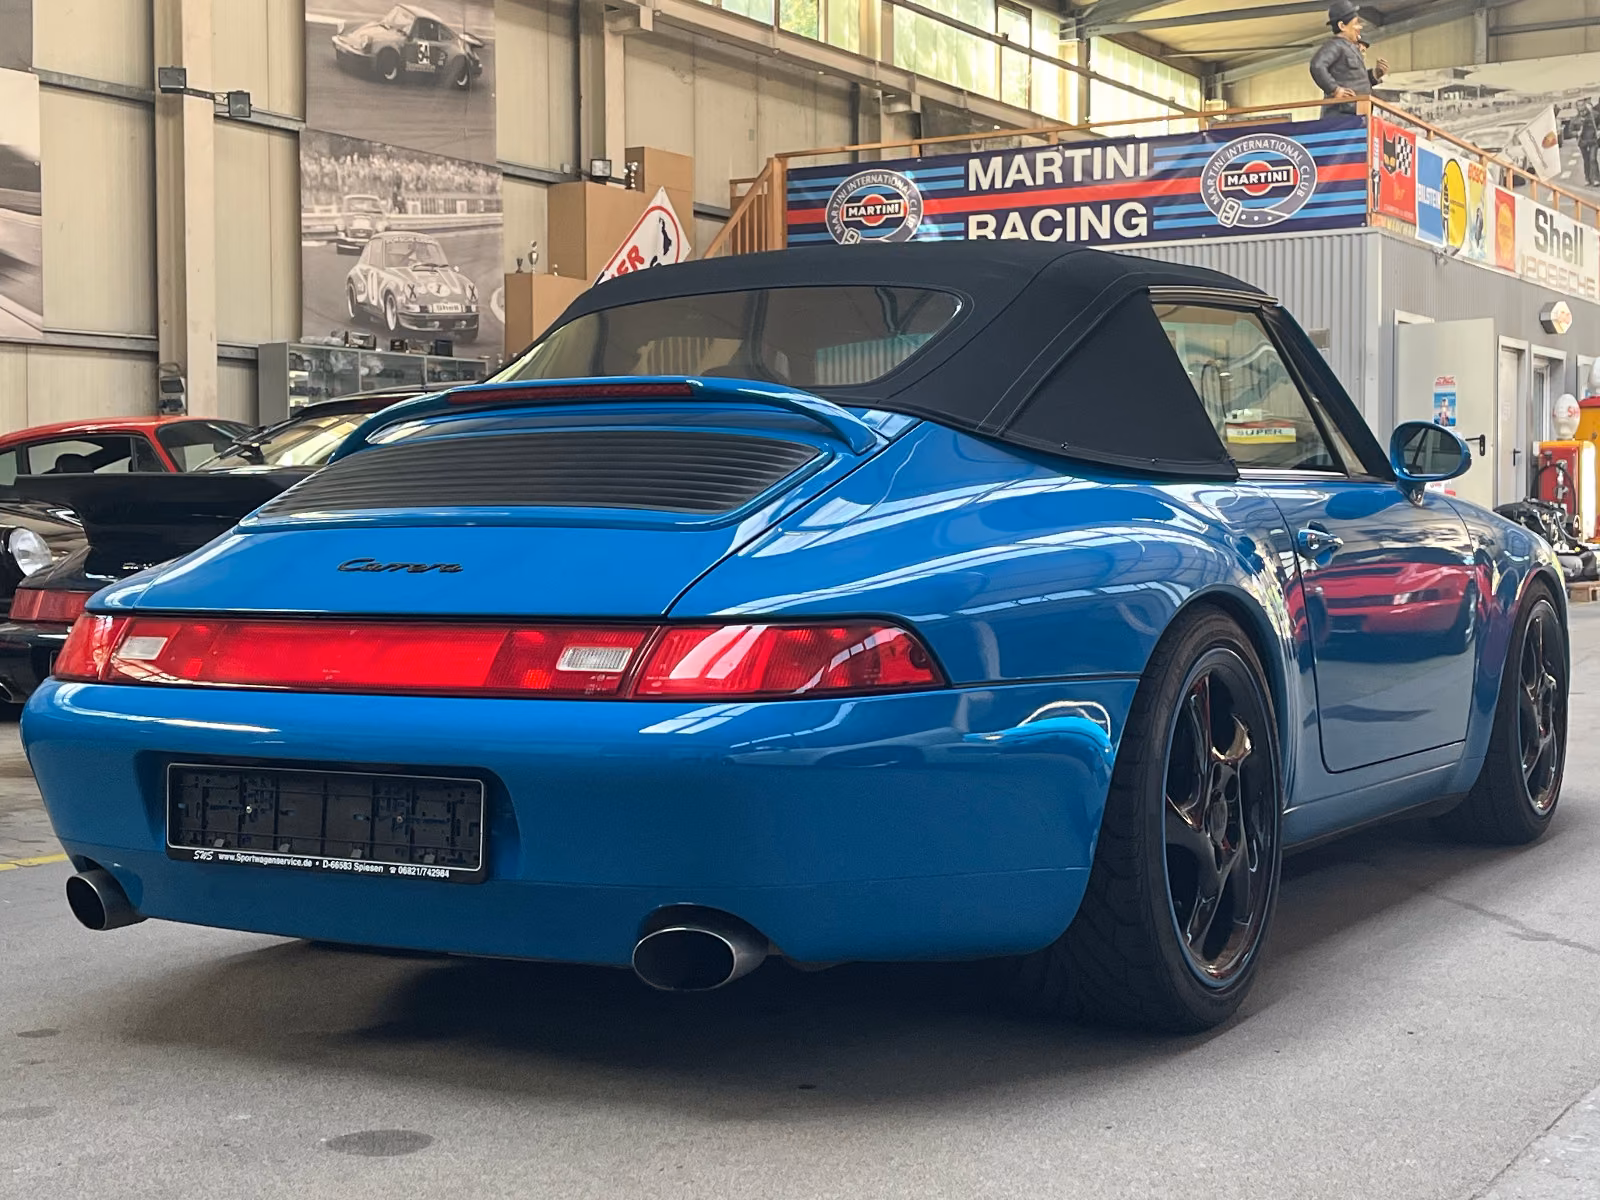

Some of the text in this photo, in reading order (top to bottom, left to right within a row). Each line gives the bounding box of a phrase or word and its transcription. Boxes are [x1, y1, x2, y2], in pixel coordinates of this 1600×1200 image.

[968, 142, 1149, 192] MARTINI
[1207, 139, 1310, 205] MARTINI INTERNATIONAL CLUB
[1227, 170, 1288, 186] MARTINI
[831, 189, 848, 234] MARTINI
[906, 199, 918, 228] CLUB
[848, 203, 899, 217] MARTINI
[968, 201, 1148, 243] RACING
[1534, 207, 1584, 268] Shell
[337, 557, 463, 573] Carrera
[218, 853, 313, 868] www.Sportwagenservice.de
